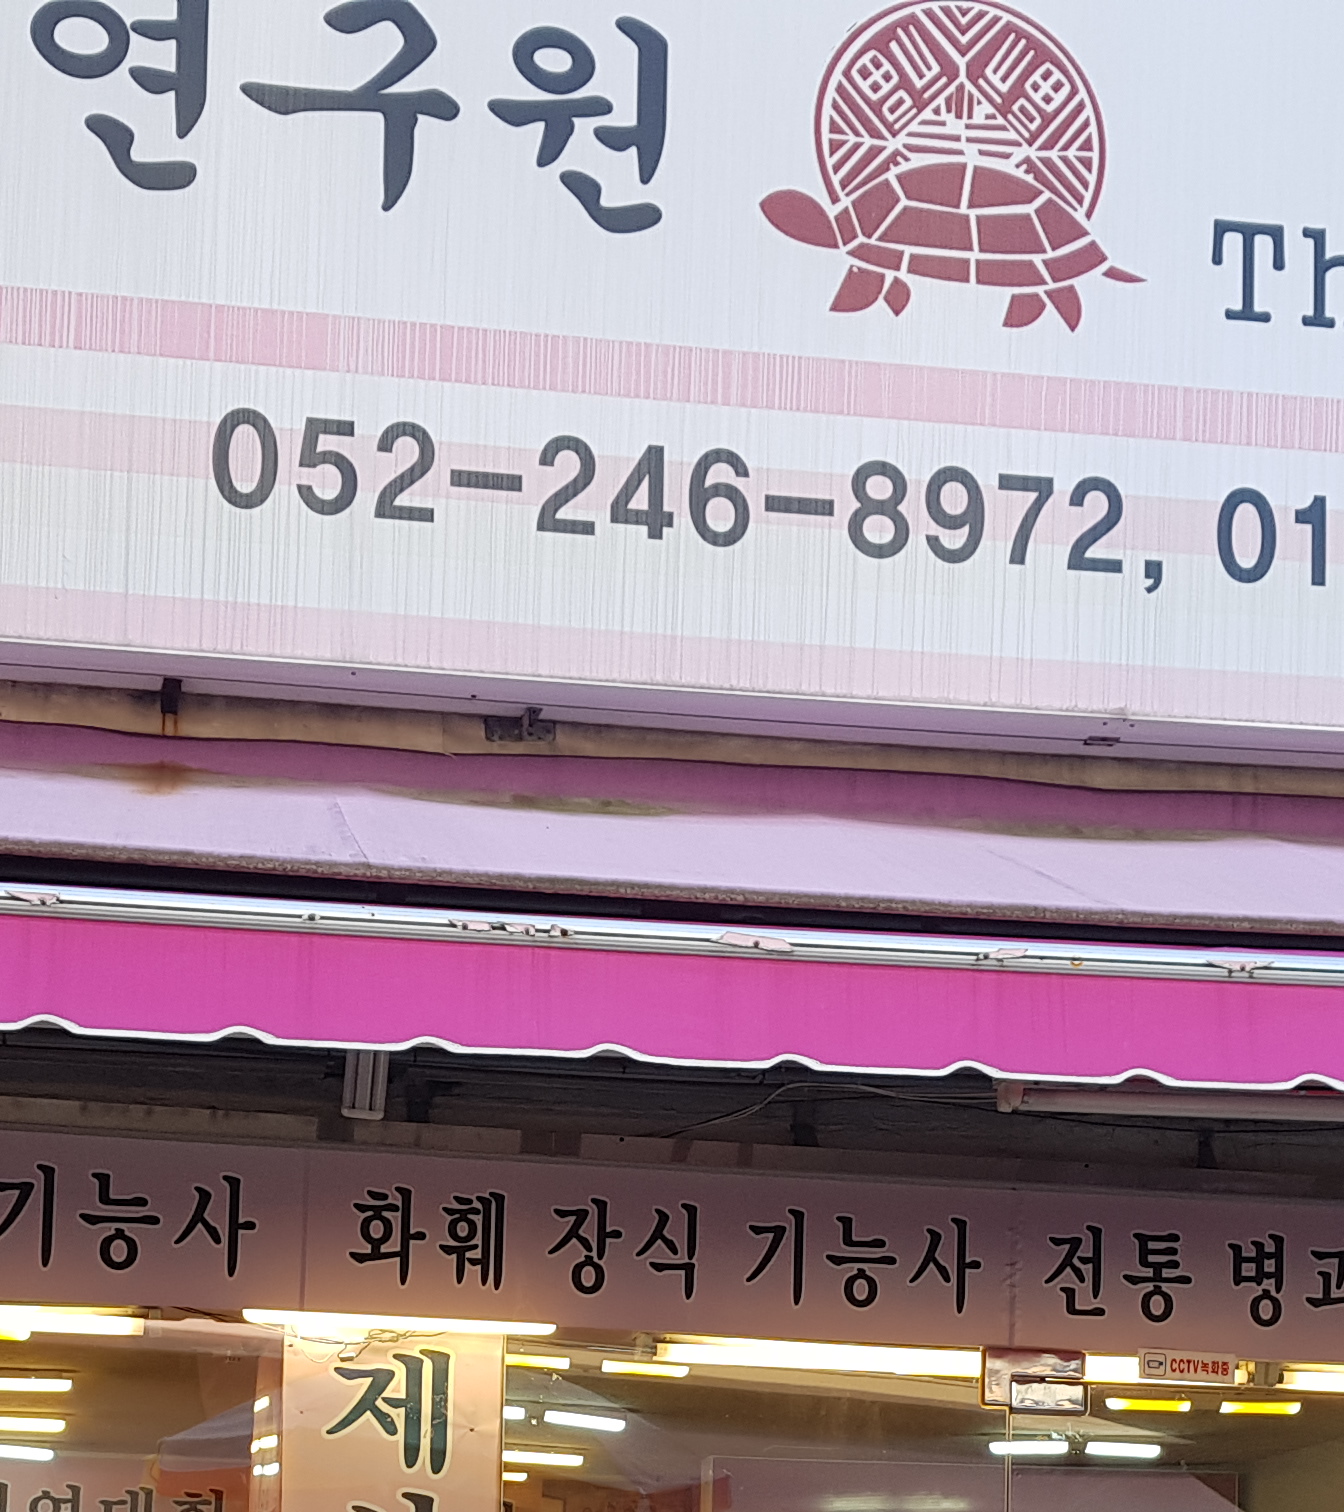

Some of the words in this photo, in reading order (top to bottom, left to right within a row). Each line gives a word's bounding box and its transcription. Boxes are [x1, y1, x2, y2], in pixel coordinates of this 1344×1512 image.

[31, 0, 670, 234] 연구원
[212, 408, 1164, 593] 052-246-8972,
[348, 1185, 507, 1292] 화훼
[547, 1198, 699, 1302] 장식
[745, 1208, 982, 1316] 기능사
[1043, 1224, 1193, 1326] 전통
